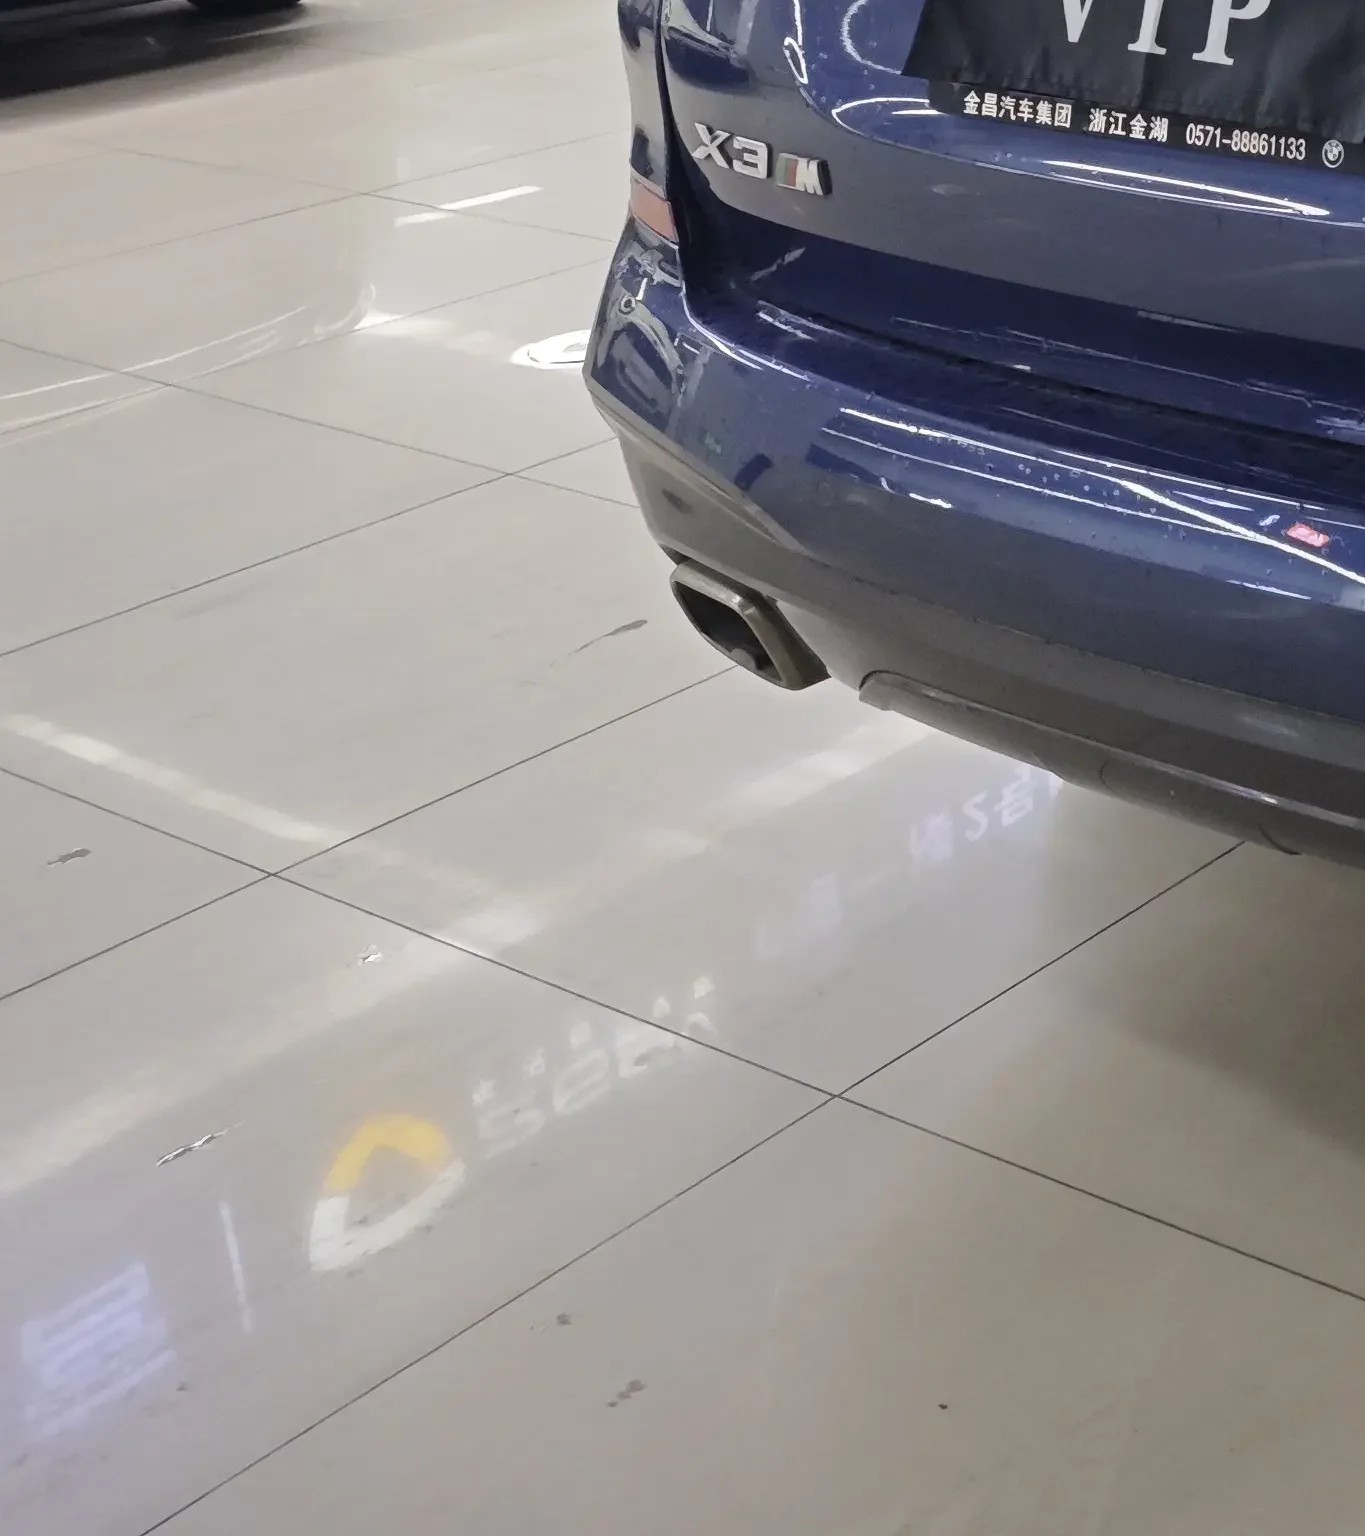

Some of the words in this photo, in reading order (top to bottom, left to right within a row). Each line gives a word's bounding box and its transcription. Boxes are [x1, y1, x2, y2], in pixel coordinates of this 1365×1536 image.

[692, 121, 769, 180] X3
[962, 89, 1073, 129] 金昌汽车集团
[1088, 108, 1169, 143] 浙江金湖
[1186, 122, 1306, 161] 0571-88861133
